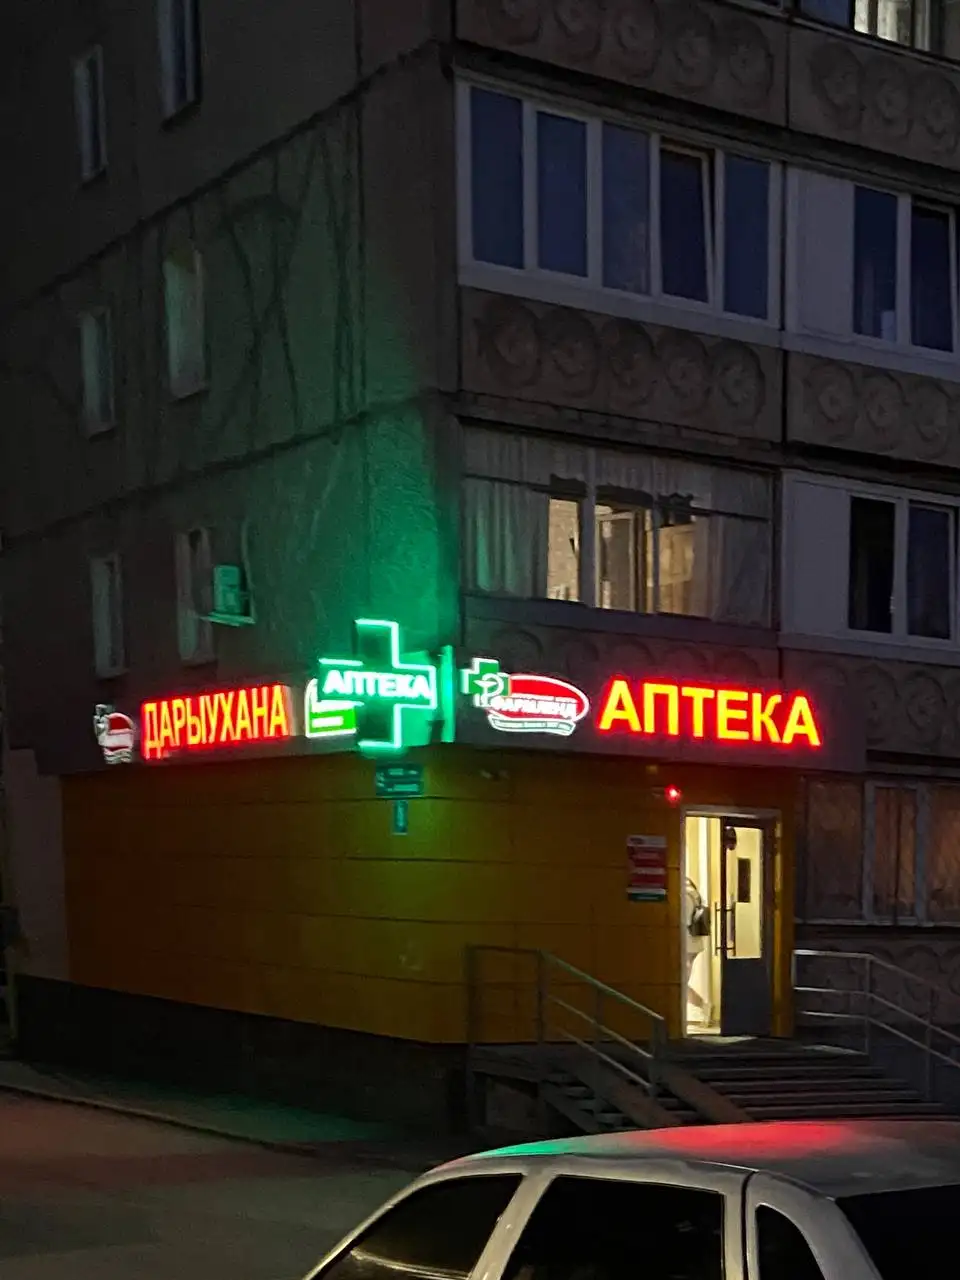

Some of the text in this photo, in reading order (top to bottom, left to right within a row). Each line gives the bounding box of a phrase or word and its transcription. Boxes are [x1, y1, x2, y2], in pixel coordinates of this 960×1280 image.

[323, 669, 432, 699] АПТЕКА
[599, 679, 821, 747] АПТЕКА
[144, 685, 287, 759] ДАРЫУХАНА
